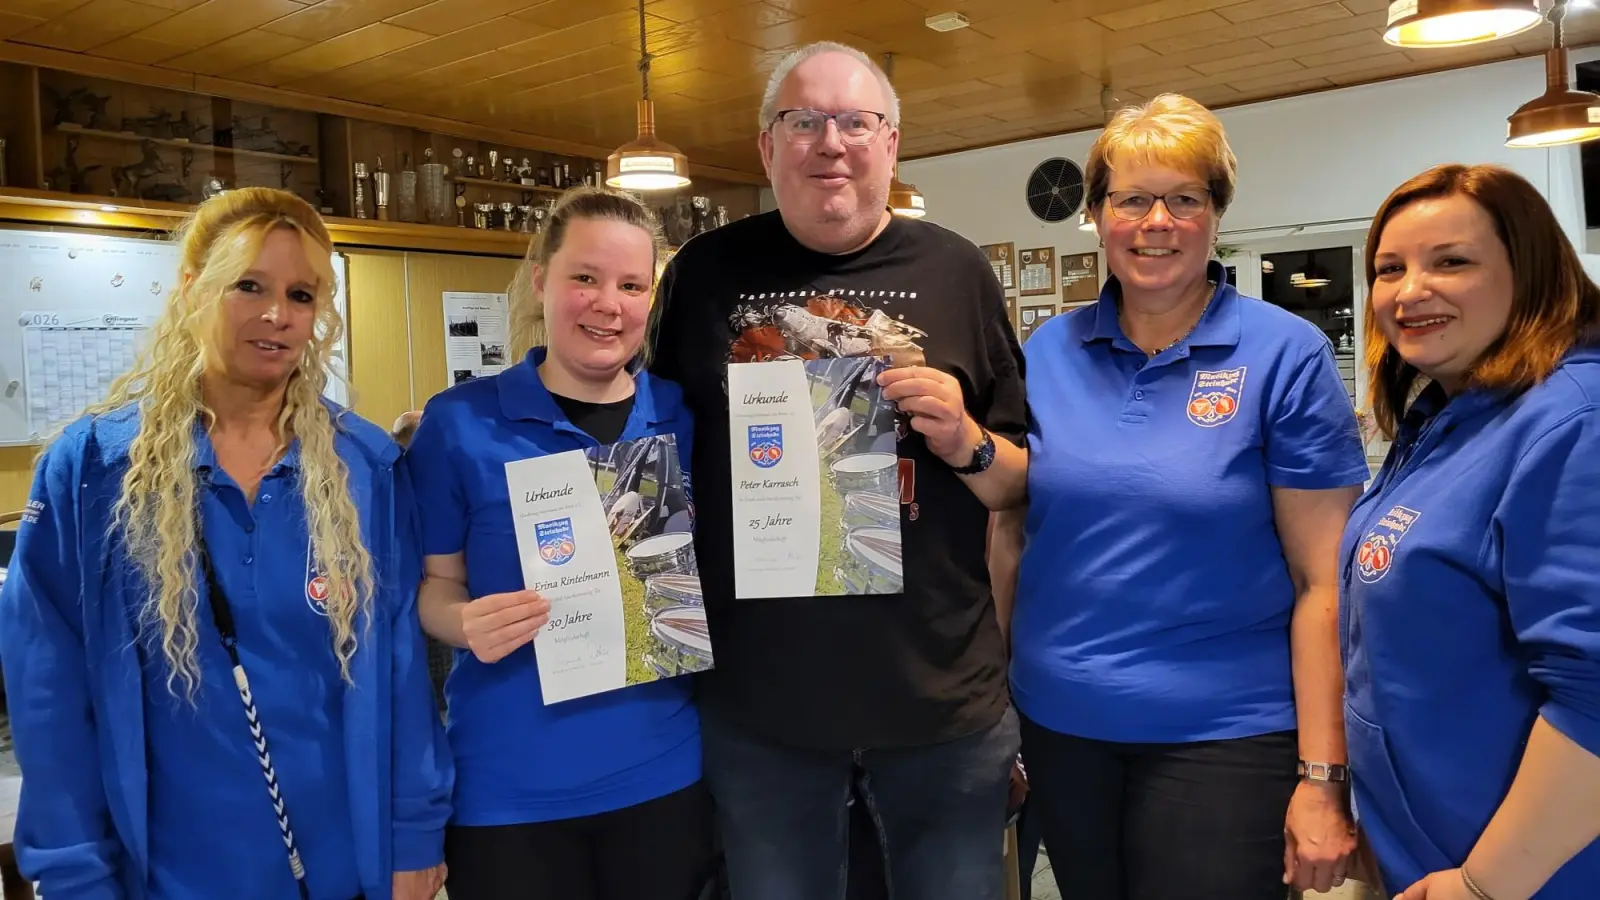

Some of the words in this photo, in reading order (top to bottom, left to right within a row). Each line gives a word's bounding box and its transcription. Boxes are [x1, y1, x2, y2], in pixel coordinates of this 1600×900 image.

[739, 290, 816, 300] TACTICAL
[24, 314, 59, 326] 026
[743, 390, 789, 405] Urkunde
[740, 480, 761, 490] Peter
[762, 477, 799, 489] Karrasch
[525, 482, 574, 503] Urkunde
[748, 519, 760, 530] 25
[761, 512, 793, 530] Jahre
[534, 580, 558, 592] Erina
[560, 570, 610, 587] Rintelmann
[547, 618, 561, 631] 30
[561, 610, 593, 630] Jahre
